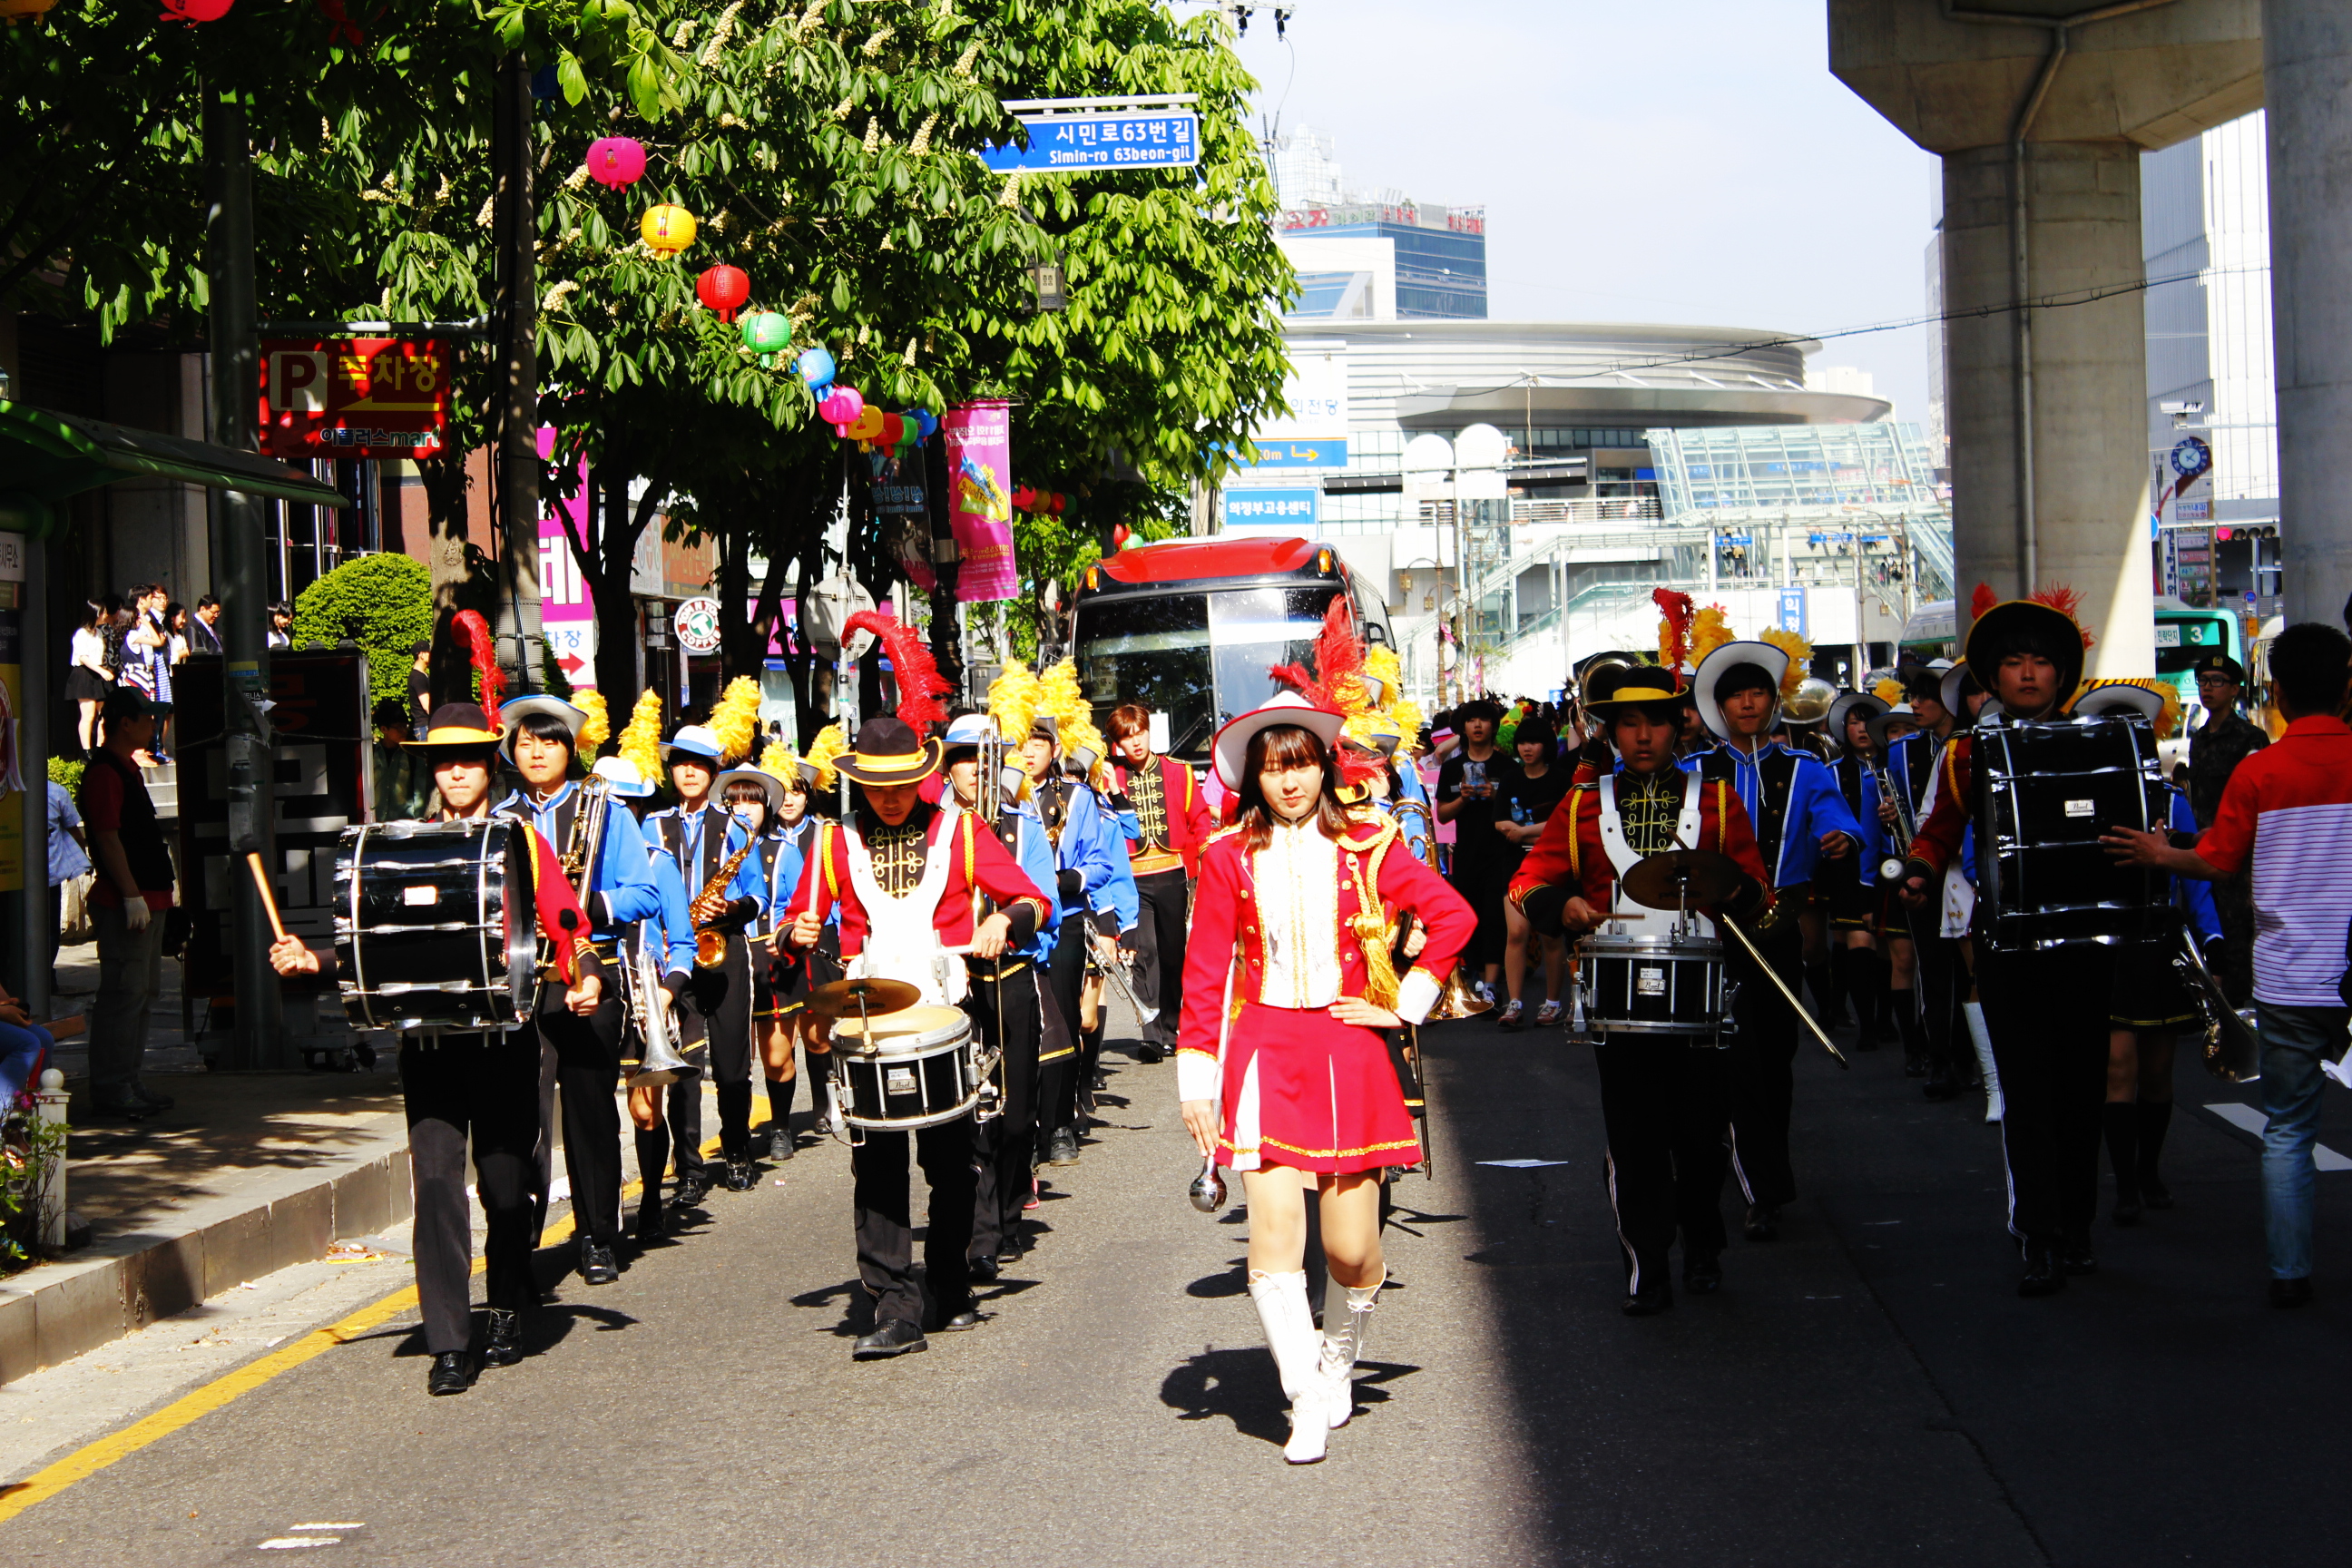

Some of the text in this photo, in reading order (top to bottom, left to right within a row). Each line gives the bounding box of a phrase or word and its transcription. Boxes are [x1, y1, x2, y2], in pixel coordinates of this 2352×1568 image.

[1055, 119, 1191, 146] 시민로63번길
[1049, 145, 1191, 164] Simin-ro 63beon-gil
[280, 354, 318, 408] P
[338, 354, 441, 392] 주차장
[1228, 500, 1311, 517] 의정부고용센터
[678, 604, 695, 626] TOM
[694, 601, 703, 611] N
[681, 629, 721, 648] COFFEE
[2190, 626, 2203, 643] 3
[1837, 662, 1847, 675] P
